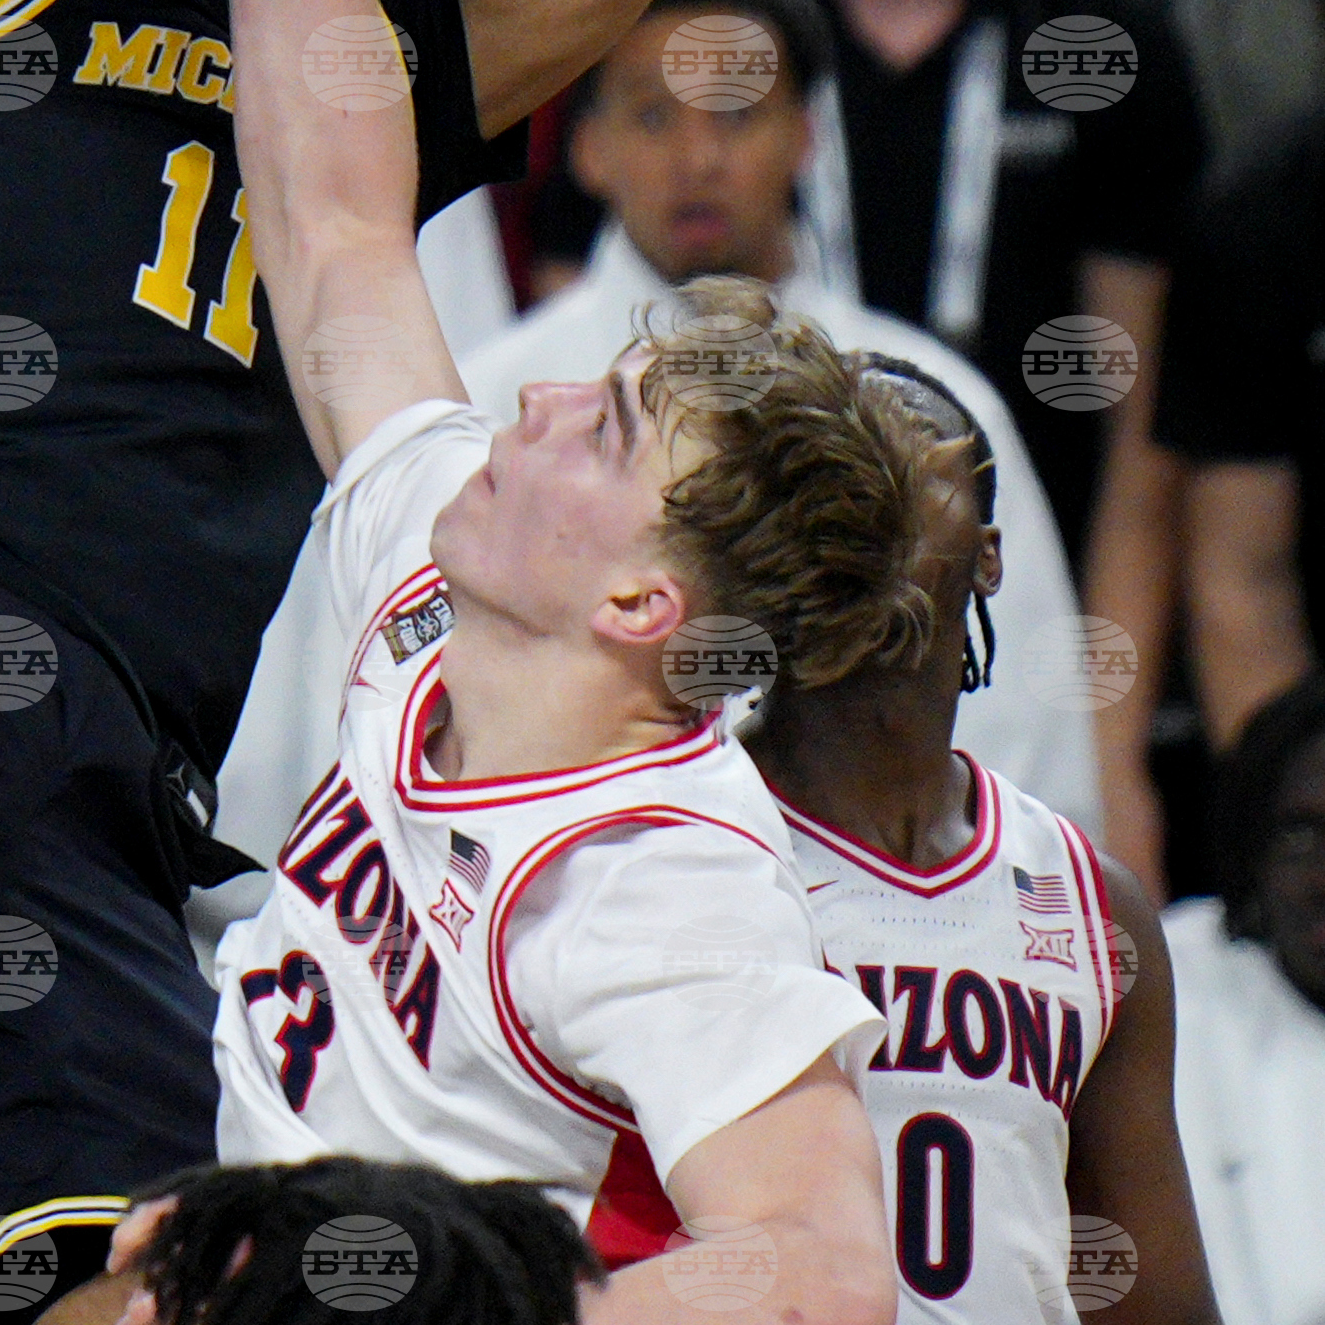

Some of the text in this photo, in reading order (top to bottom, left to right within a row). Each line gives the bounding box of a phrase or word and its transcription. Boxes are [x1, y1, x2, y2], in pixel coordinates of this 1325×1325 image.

[132, 140, 259, 369] 11
[277, 759, 441, 1073] IZONA
[821, 939, 1083, 1123] IZONA
[896, 1112, 974, 1300] 0
